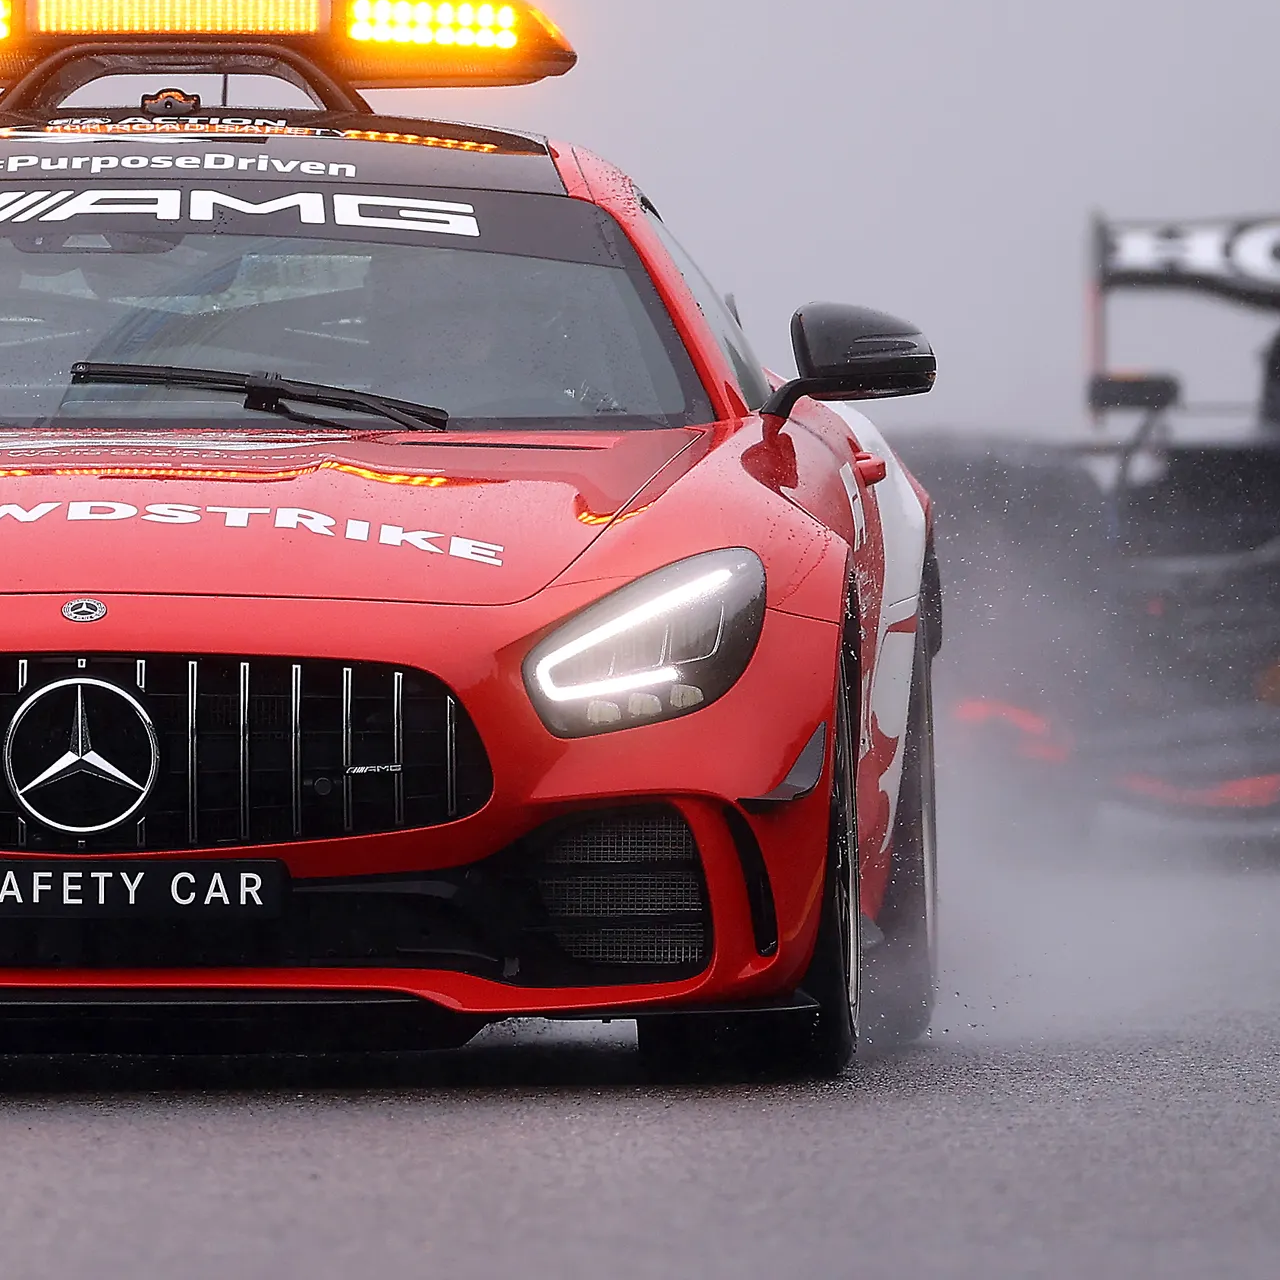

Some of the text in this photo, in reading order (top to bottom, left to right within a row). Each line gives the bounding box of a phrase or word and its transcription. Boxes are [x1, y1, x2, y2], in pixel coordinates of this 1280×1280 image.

[118, 116, 287, 127] ACTION
[216, 124, 350, 138] SAFETY
[170, 871, 263, 906] CAR
